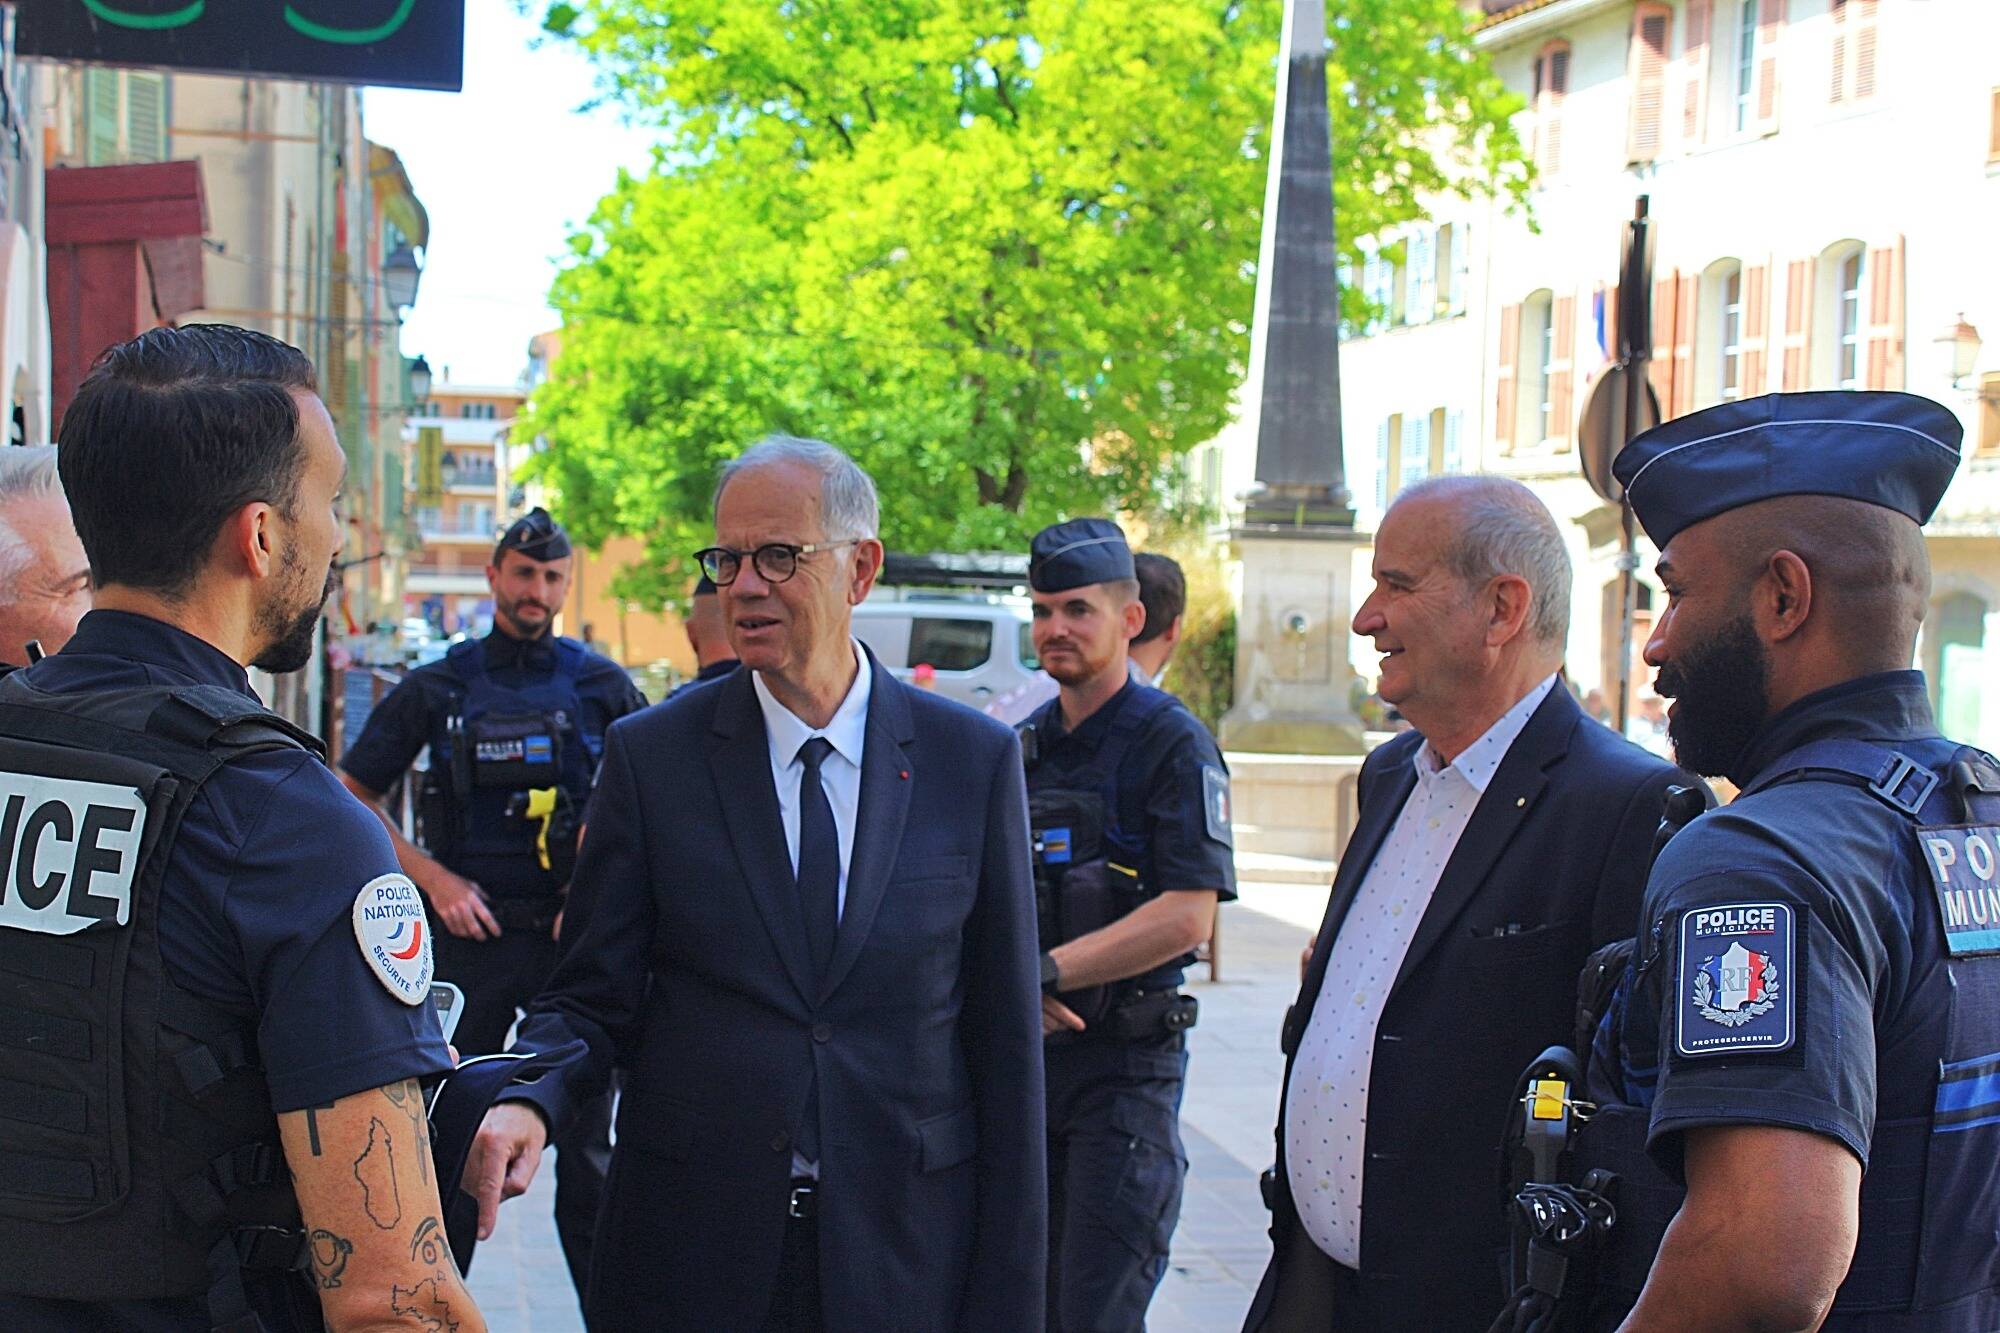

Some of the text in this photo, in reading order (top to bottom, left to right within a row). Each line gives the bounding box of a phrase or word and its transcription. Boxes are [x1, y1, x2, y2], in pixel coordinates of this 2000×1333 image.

[1926, 834, 2000, 883] PO
[376, 886, 412, 901] POLICE
[364, 904, 422, 921] NATIONALE
[1696, 908, 1775, 929] POLICE
[1696, 924, 1774, 935] MUNICIPALE
[373, 945, 412, 992] SECURITE
[1719, 966, 1753, 993] RF
